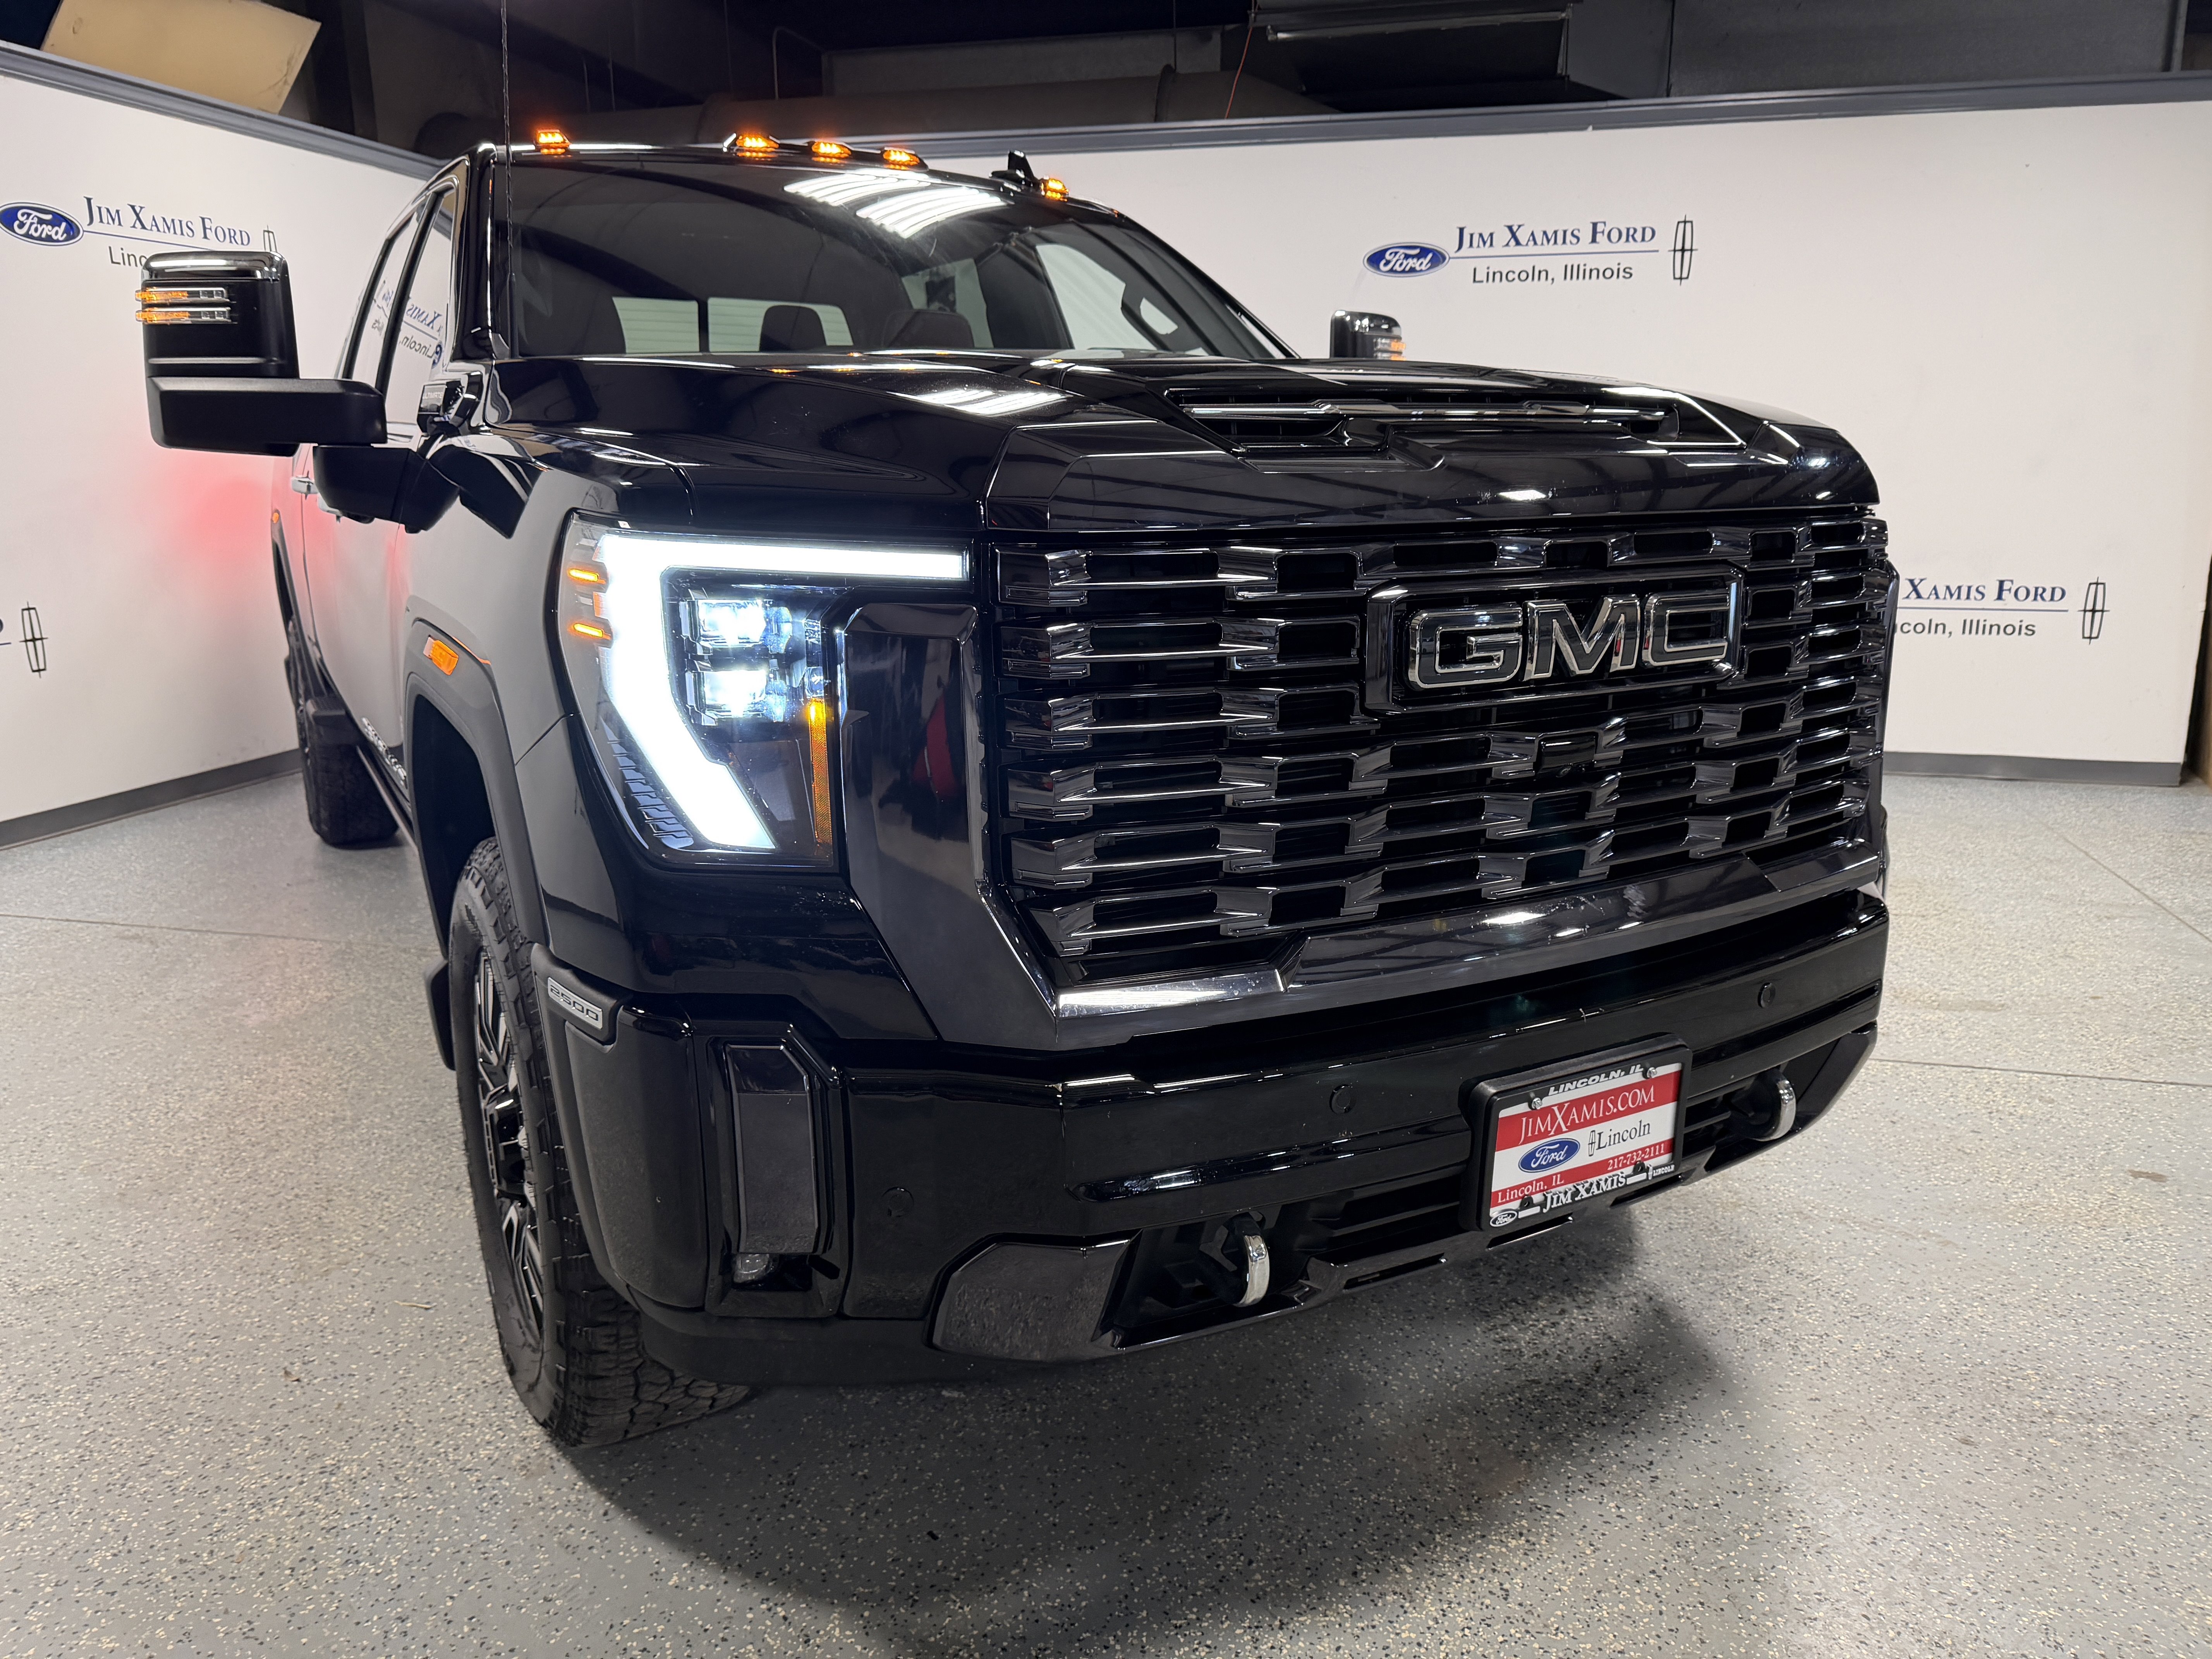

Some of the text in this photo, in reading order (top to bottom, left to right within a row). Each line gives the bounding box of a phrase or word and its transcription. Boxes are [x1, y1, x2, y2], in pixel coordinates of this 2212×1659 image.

[14, 209, 67, 240] Ford
[83, 196, 251, 246] JIM XAMIS FORD
[1455, 221, 1656, 253] JIM XAMIS FORD
[108, 245, 147, 267] Linc
[1379, 248, 1433, 271] Ford
[1472, 263, 1633, 284] Lincoln, Illinois
[1902, 577, 2066, 602] XAMIS FORD
[1407, 592, 1731, 689] GMC
[1896, 619, 2036, 638] coln, Illinois
[550, 985, 599, 1022] 2500
[1548, 1064, 1644, 1096] LINCOLN, IL
[1518, 1085, 1655, 1145] JIMXAMIS.COM
[1595, 1120, 1651, 1150] Lincoln
[1531, 1144, 1568, 1168] Ford
[1607, 1143, 1664, 1171] 217-732-2111
[1653, 1164, 1675, 1176] LINCOLN
[1498, 1174, 1565, 1203] Lincoln, IL
[1543, 1173, 1626, 1213] JIM XAMIS
[1496, 1213, 1514, 1225] Ford
